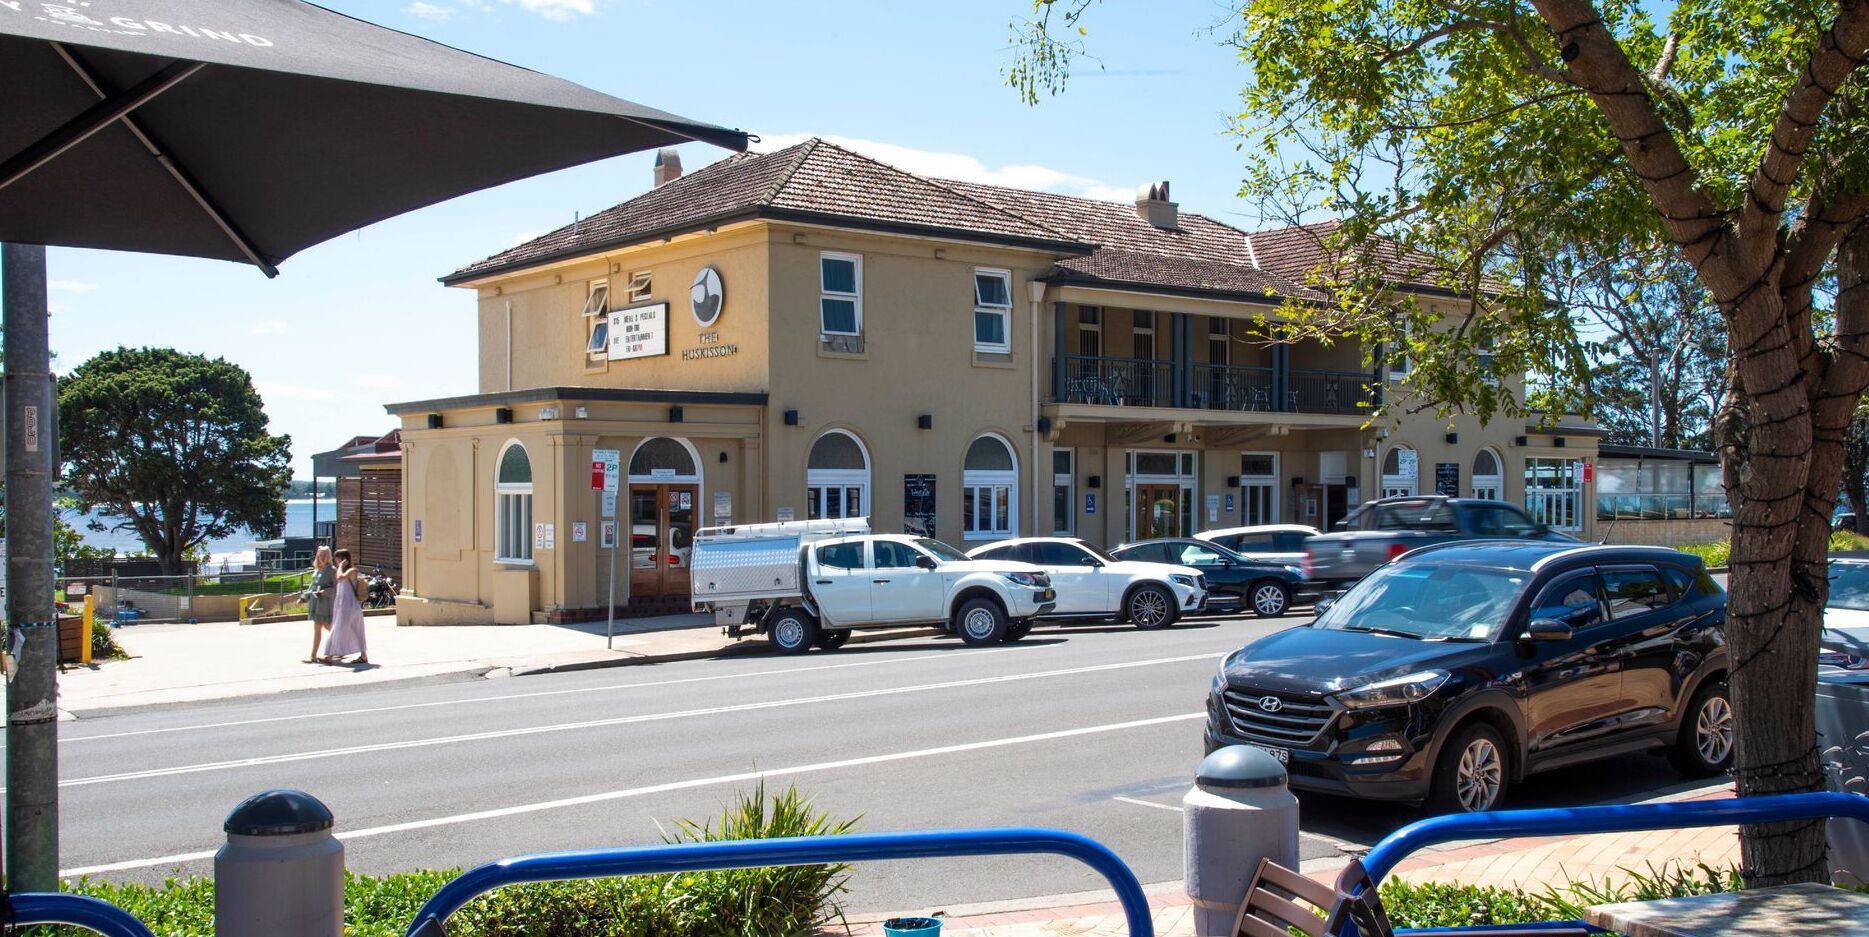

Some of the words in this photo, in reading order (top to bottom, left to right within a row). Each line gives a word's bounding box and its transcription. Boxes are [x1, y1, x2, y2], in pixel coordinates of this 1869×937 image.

[110, 16, 274, 47] GRIND
[698, 332, 718, 344] THE
[682, 344, 736, 361] HUSKISSON
[606, 464, 618, 472] 2P
